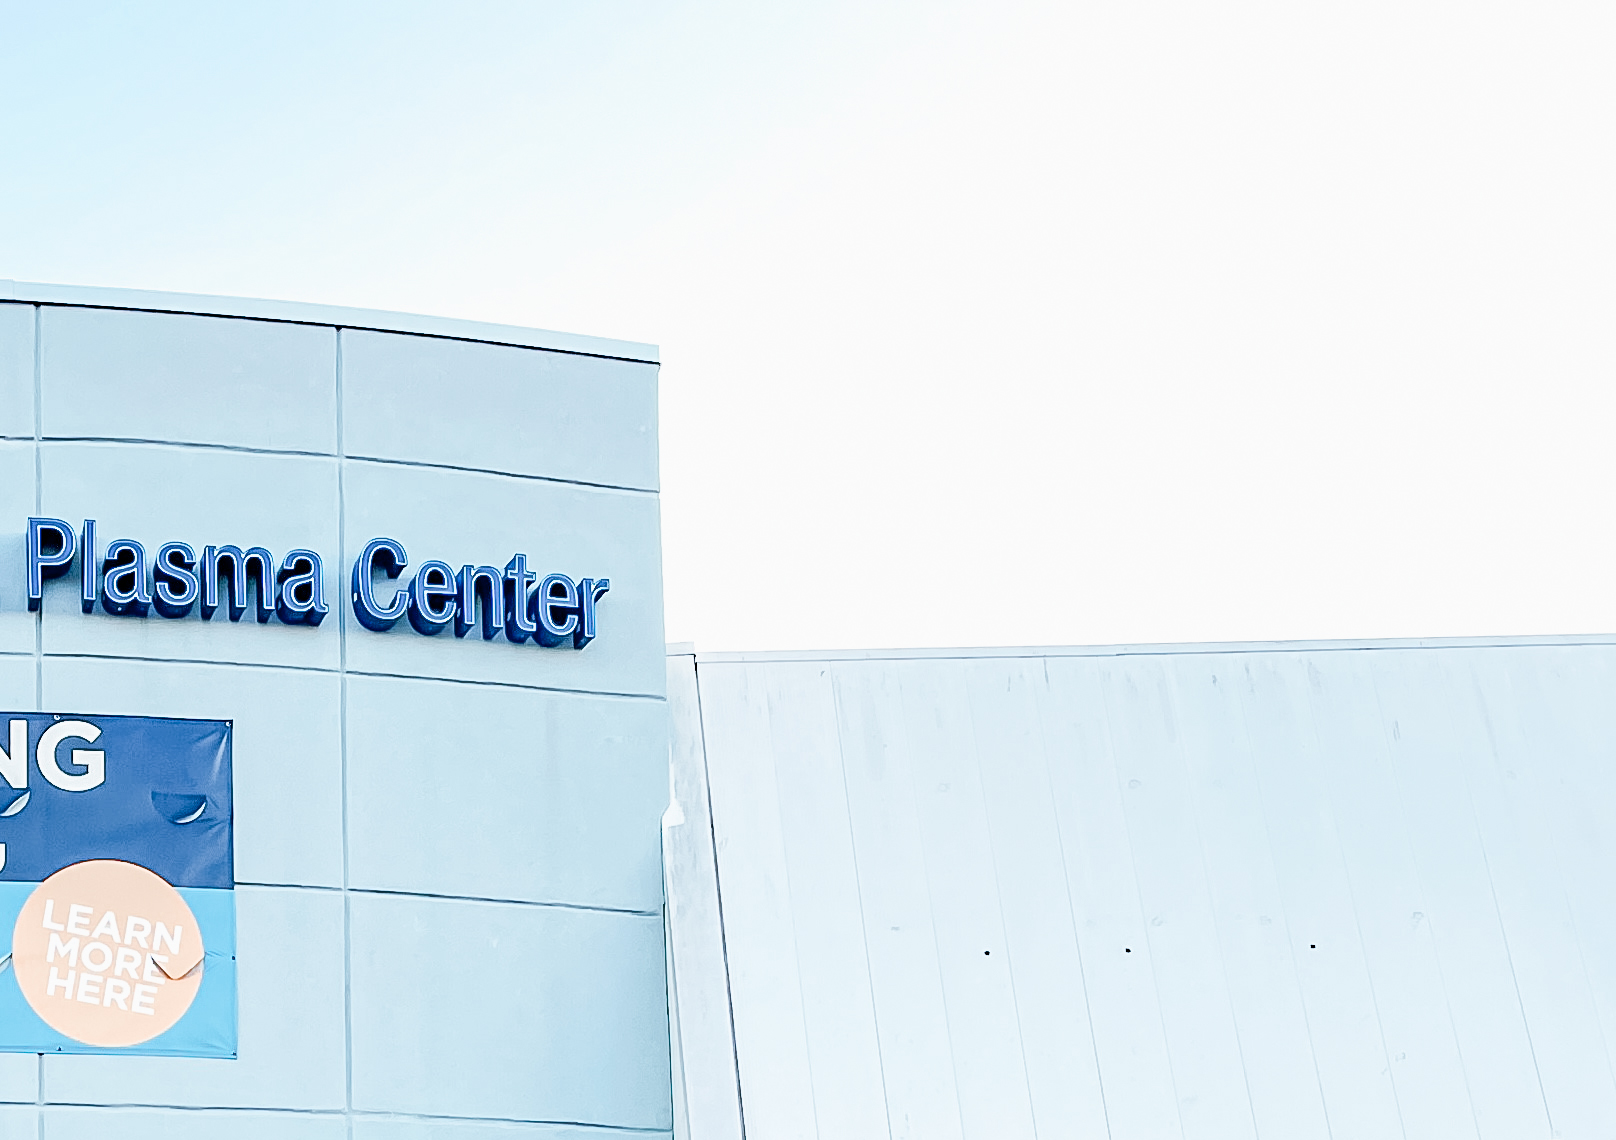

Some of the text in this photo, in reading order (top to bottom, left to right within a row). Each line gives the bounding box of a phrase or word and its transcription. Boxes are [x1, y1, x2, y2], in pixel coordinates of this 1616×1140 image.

[27, 517, 330, 621] Plasma
[353, 537, 610, 646] Center
[42, 899, 182, 955] LEARN
[46, 932, 169, 985] MORE
[47, 966, 158, 1015] HERE
